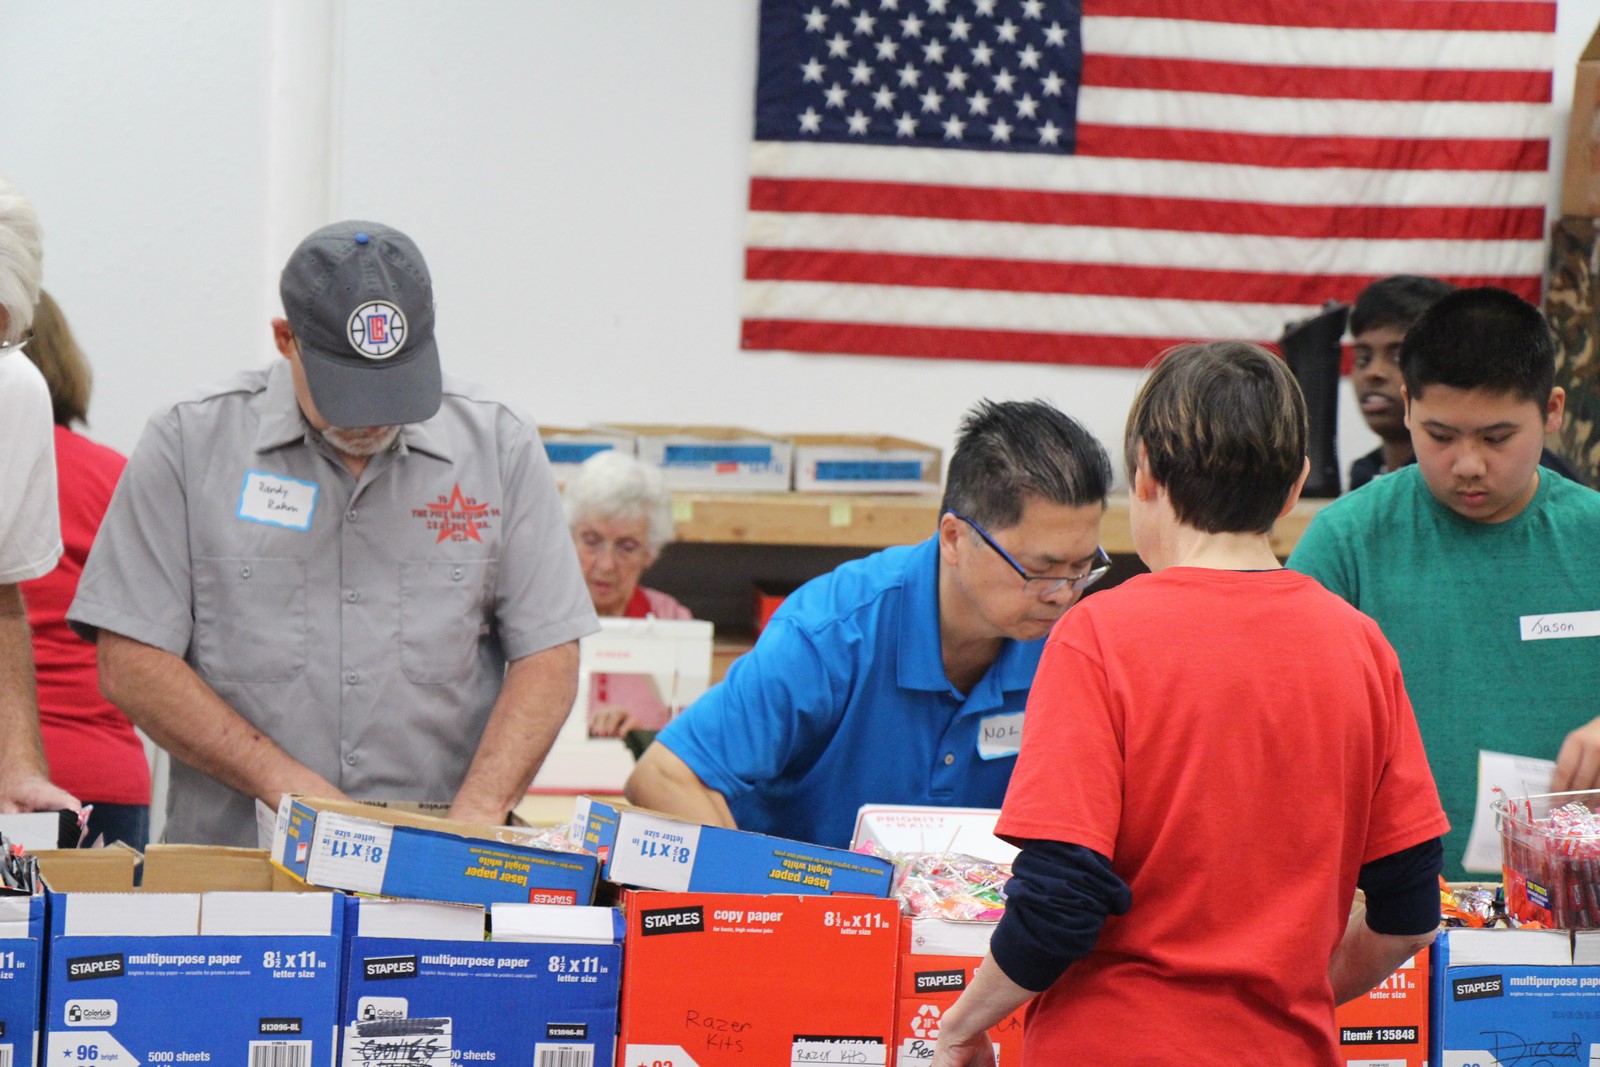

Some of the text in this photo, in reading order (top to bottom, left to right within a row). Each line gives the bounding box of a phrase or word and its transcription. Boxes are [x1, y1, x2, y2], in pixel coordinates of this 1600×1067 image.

[259, 482, 288, 499] Randy
[1531, 617, 1575, 635] Jason
[331, 840, 348, 858] 11
[640, 840, 657, 858] 11
[478, 856, 503, 867] white
[504, 861, 531, 873] bright
[782, 859, 807, 870] white
[464, 866, 529, 887] laser paper
[807, 864, 833, 877] bright
[769, 868, 831, 891] laser paper
[533, 893, 573, 905] STAPLES
[644, 911, 700, 929] STAPLES
[713, 909, 784, 924] copy paper
[863, 912, 881, 929] 11
[881, 921, 890, 929] in
[16, 960, 26, 969] in
[128, 953, 242, 966] multipurpose paper
[298, 951, 316, 968] 11
[317, 959, 327, 968] in
[421, 954, 530, 969] multipurpose paper
[581, 956, 599, 973] 11
[600, 966, 608, 974] in
[70, 959, 121, 975] STAPLES
[272, 970, 316, 978] letter size
[366, 961, 415, 976] STAPLES
[0, 971, 14, 979] ize
[557, 974, 598, 983] letter size
[918, 974, 963, 988] STAPLES
[1390, 973, 1406, 989] 11
[1407, 981, 1416, 989] in
[1510, 976, 1578, 988] multipurpose
[1369, 990, 1407, 999] letter size
[1456, 981, 1499, 995] STAPLES
[83, 1009, 112, 1017] ColorLok
[685, 1010, 752, 1032] Razer
[1343, 1029, 1415, 1041] item# 135848
[706, 1033, 744, 1053] Kits
[77, 1045, 118, 1062] 96 bright
[148, 1051, 211, 1062] 5000 sheets
[463, 1050, 496, 1061] sheets
